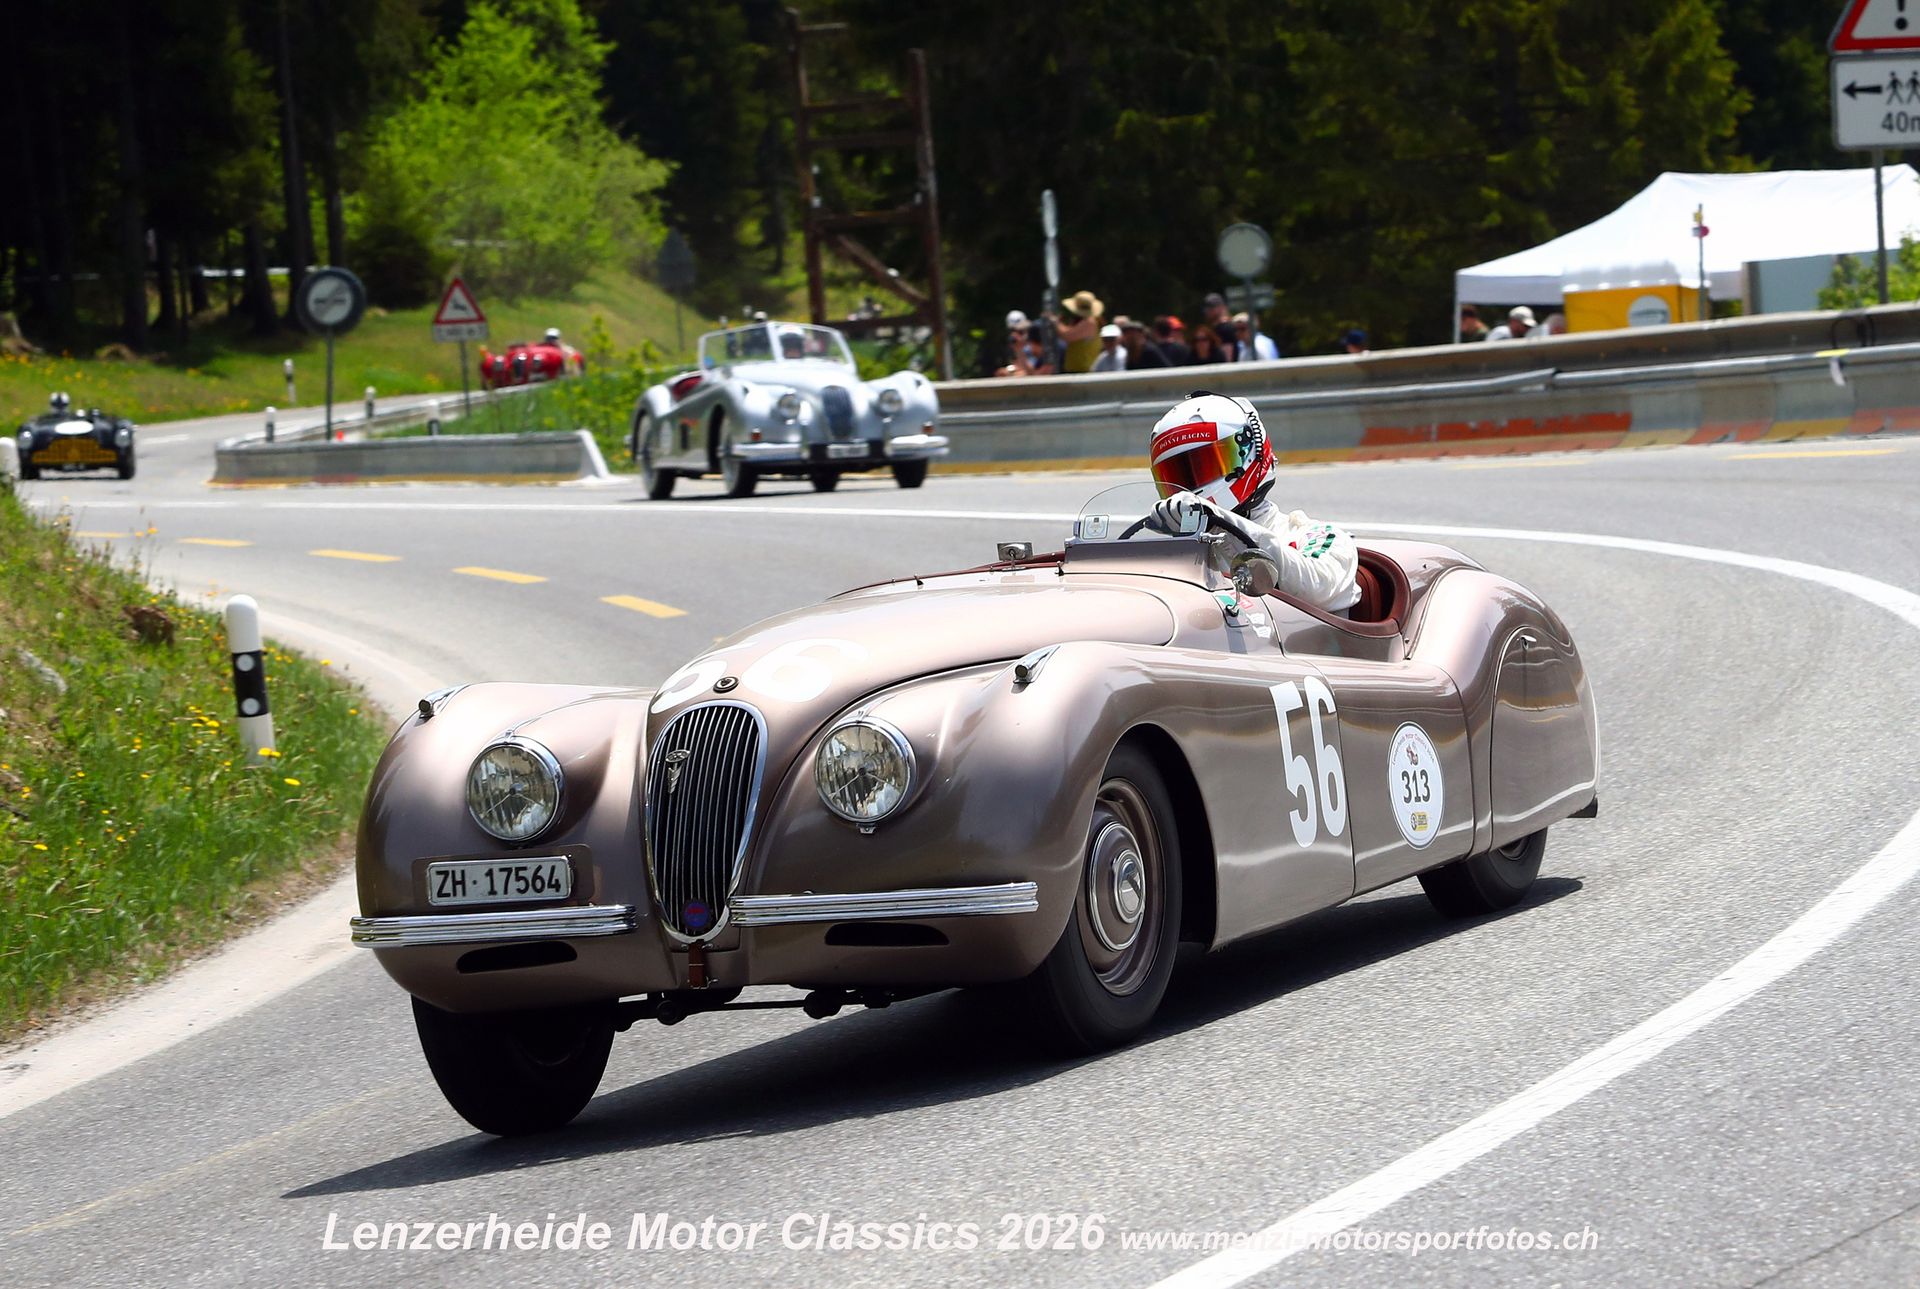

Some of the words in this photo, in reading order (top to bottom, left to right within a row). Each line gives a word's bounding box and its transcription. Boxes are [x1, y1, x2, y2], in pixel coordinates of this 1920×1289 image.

[1181, 432, 1211, 441] RACING
[1269, 676, 1346, 848] 56
[1401, 769, 1431, 804] 313
